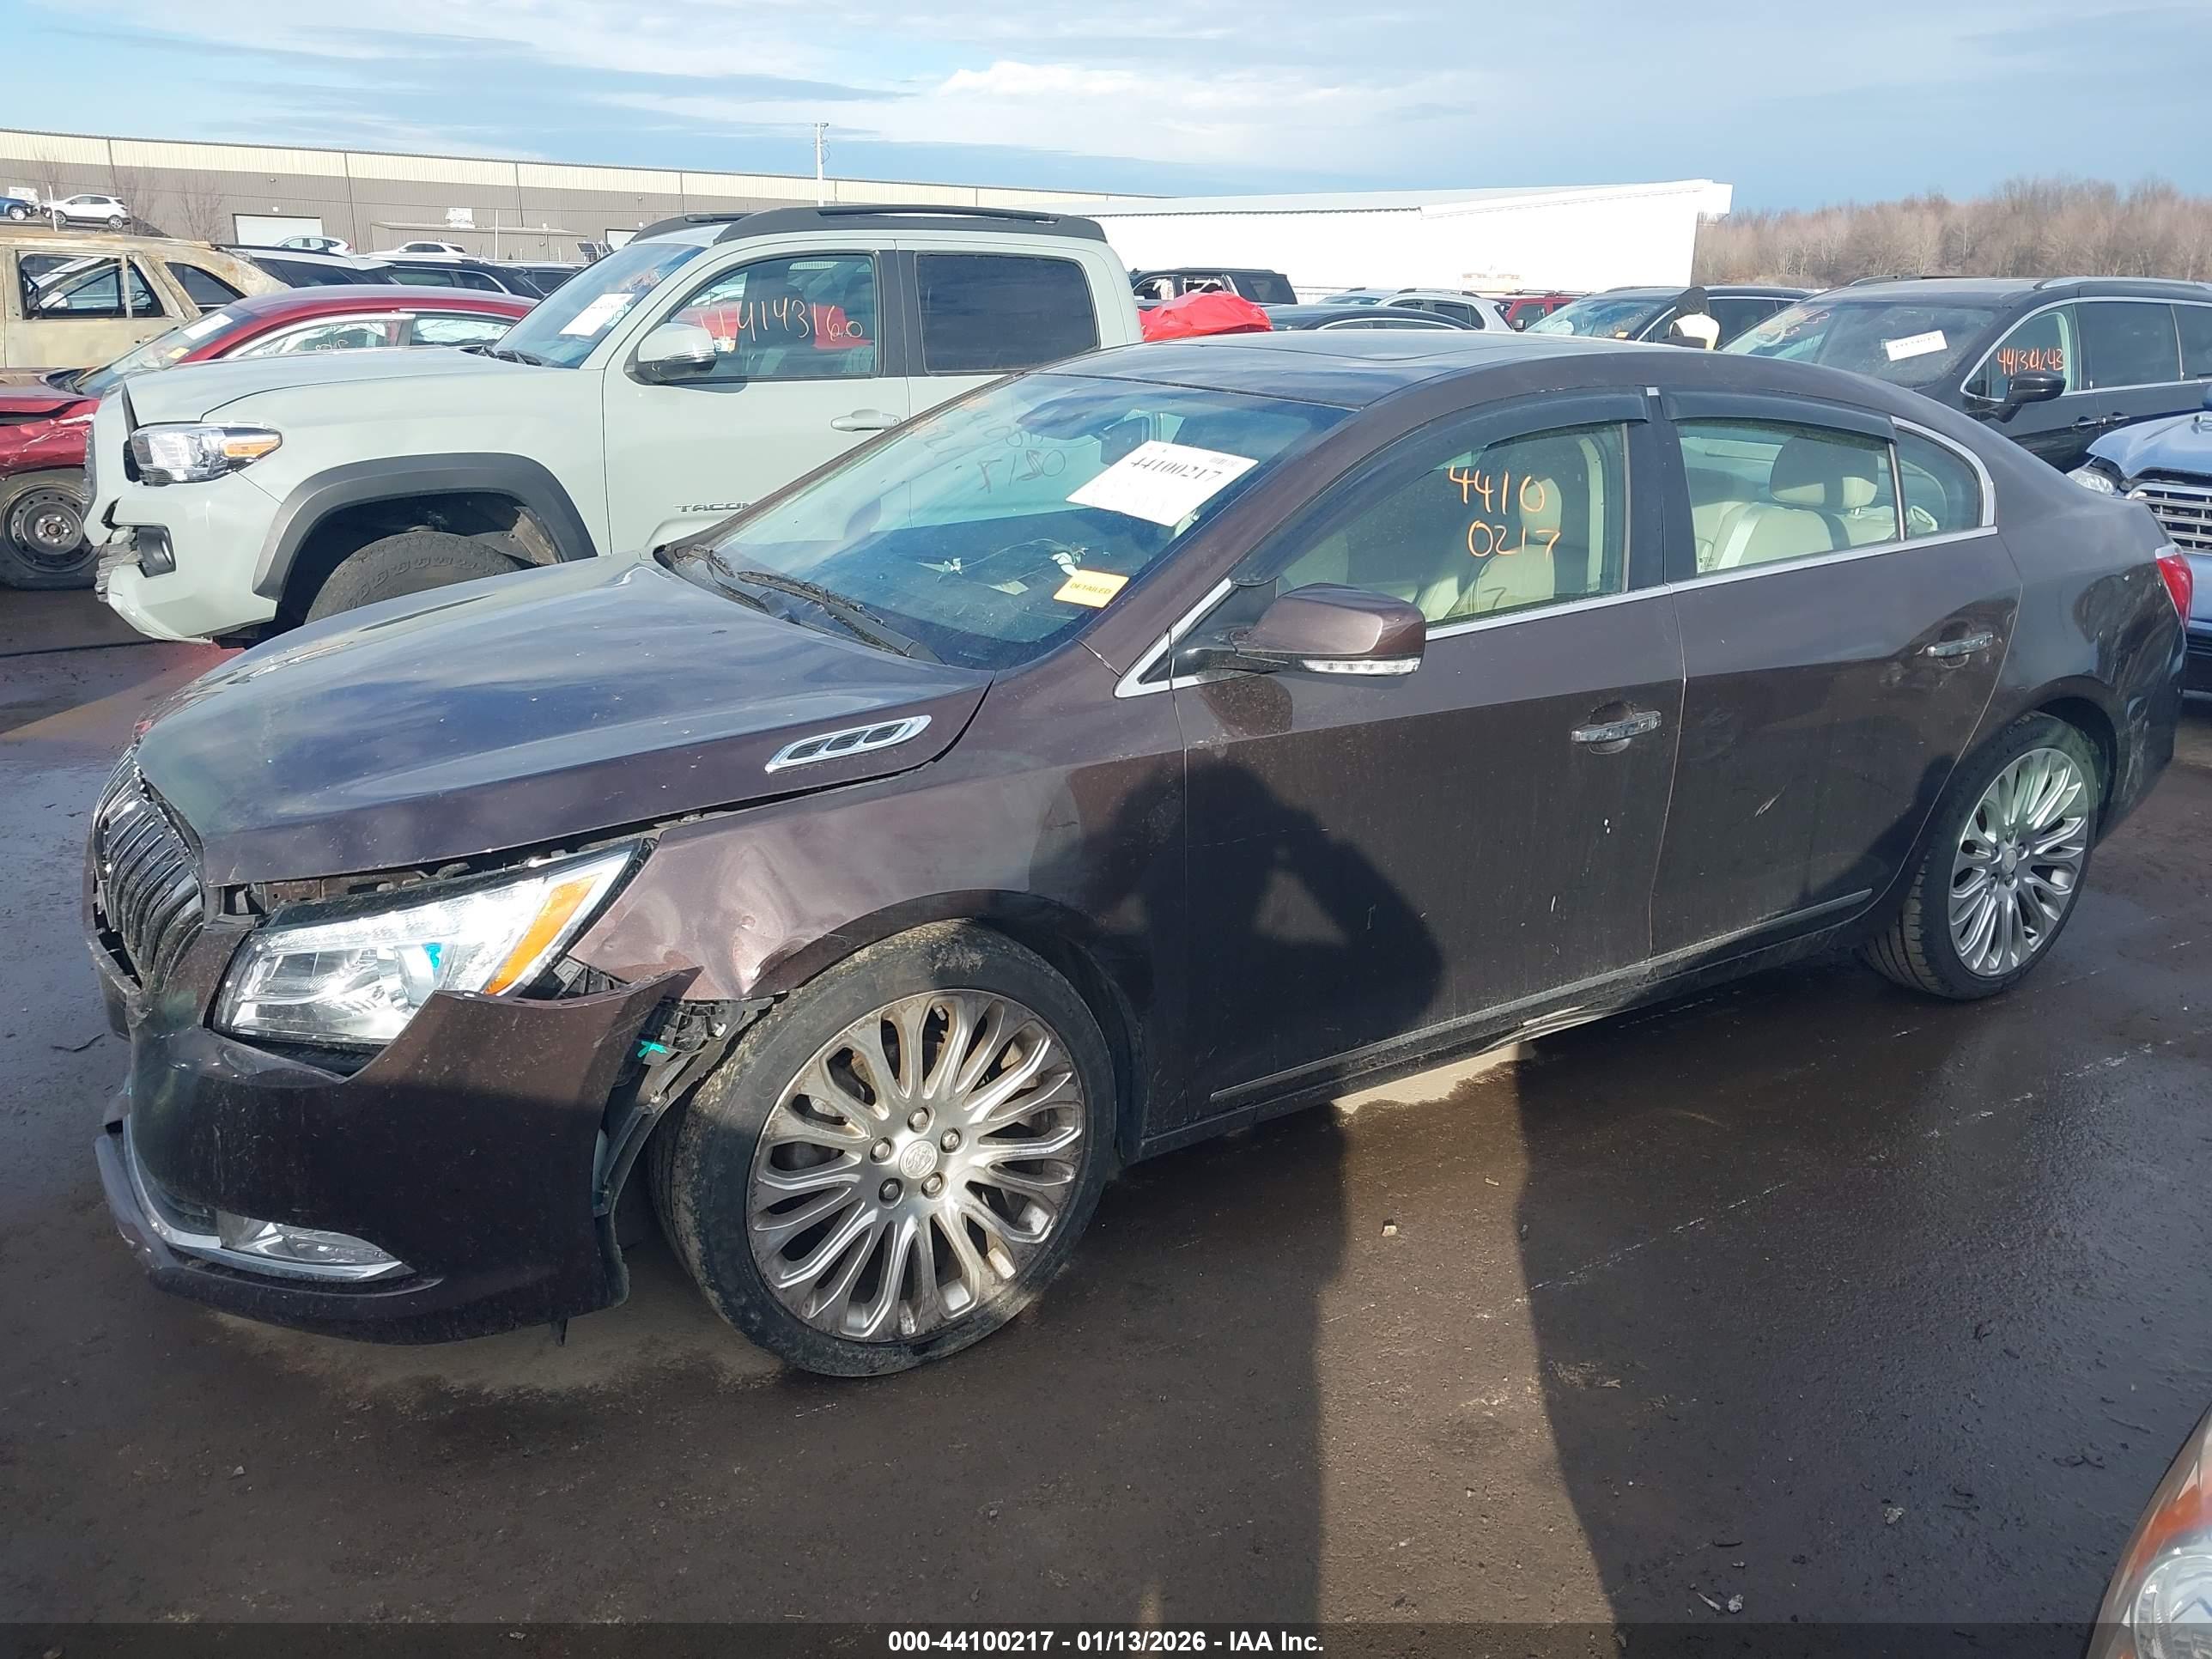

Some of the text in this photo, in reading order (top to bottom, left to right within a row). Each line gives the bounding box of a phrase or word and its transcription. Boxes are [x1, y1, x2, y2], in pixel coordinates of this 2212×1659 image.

[1448, 465, 1546, 515] 4410
[1468, 520, 1562, 562] 0217
[1069, 581, 1114, 596] DETAILED
